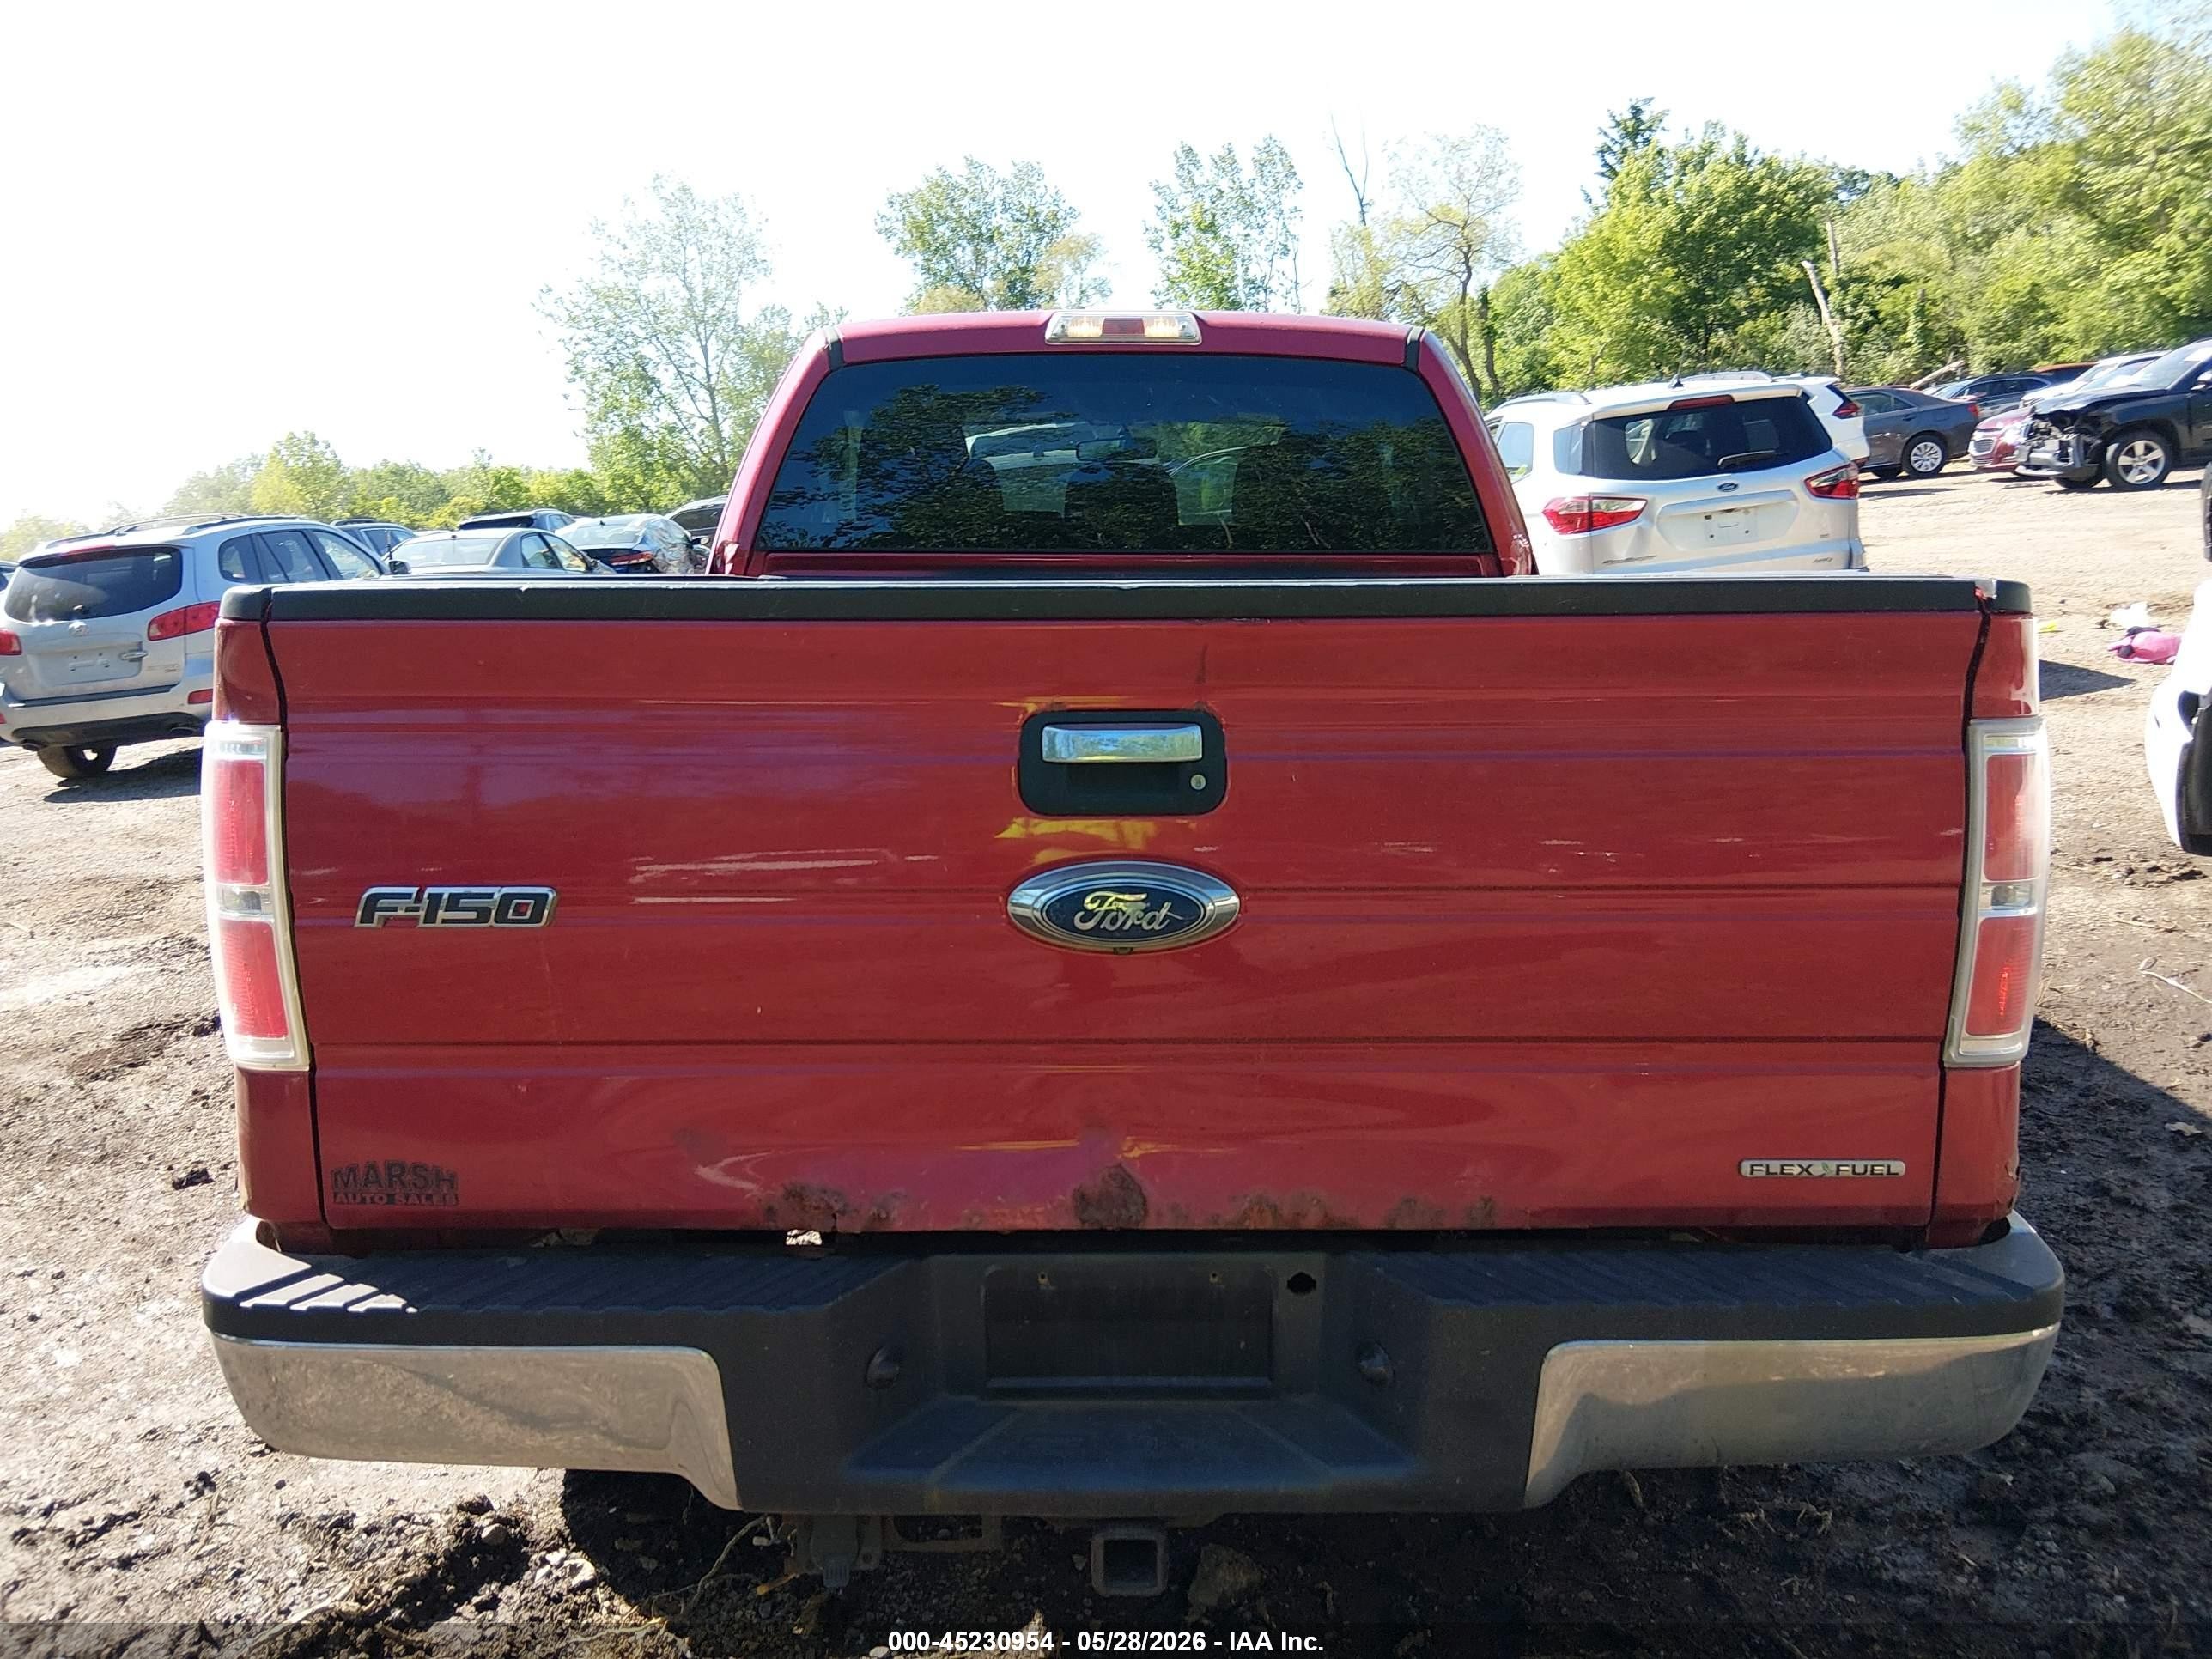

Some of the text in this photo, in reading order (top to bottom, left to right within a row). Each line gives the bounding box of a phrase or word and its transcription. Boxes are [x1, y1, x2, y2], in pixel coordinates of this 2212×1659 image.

[354, 885, 558, 927] F-150
[1073, 890, 1187, 931] Ford
[331, 1160, 459, 1190] MARSH
[1749, 1164, 1899, 1176] FLEX FUEL
[334, 1194, 387, 1205] AUTO
